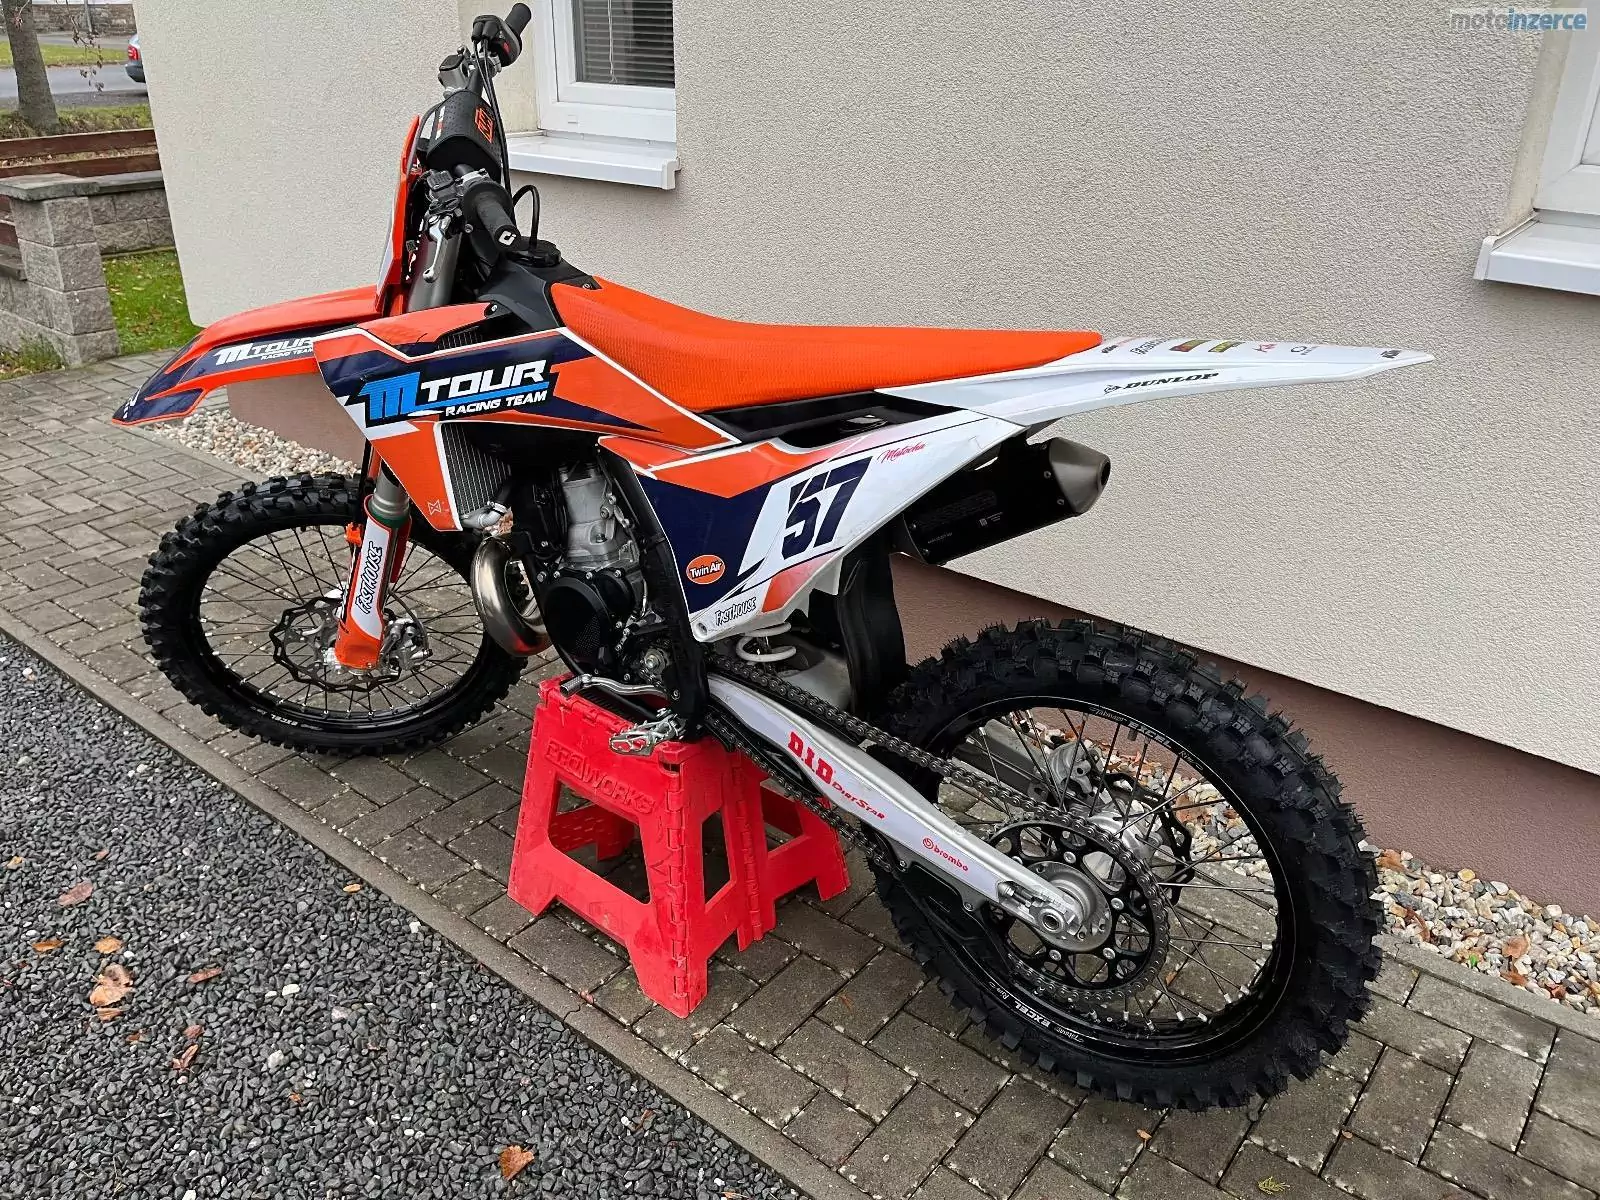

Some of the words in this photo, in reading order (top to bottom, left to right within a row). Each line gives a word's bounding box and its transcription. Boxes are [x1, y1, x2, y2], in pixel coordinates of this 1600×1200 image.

[1123, 373, 1219, 389] DUNLOP
[446, 398, 501, 417] RACING
[506, 391, 548, 406] TEAM
[781, 456, 873, 560] 57
[354, 541, 382, 614] FASTHOUSE
[690, 566, 710, 578] Twin
[710, 560, 723, 573] Air
[715, 597, 757, 626] FASTHOUSE
[1128, 721, 1172, 749] EXCEL
[934, 844, 968, 872] brembo
[1014, 1000, 1052, 1028] EXCEL
